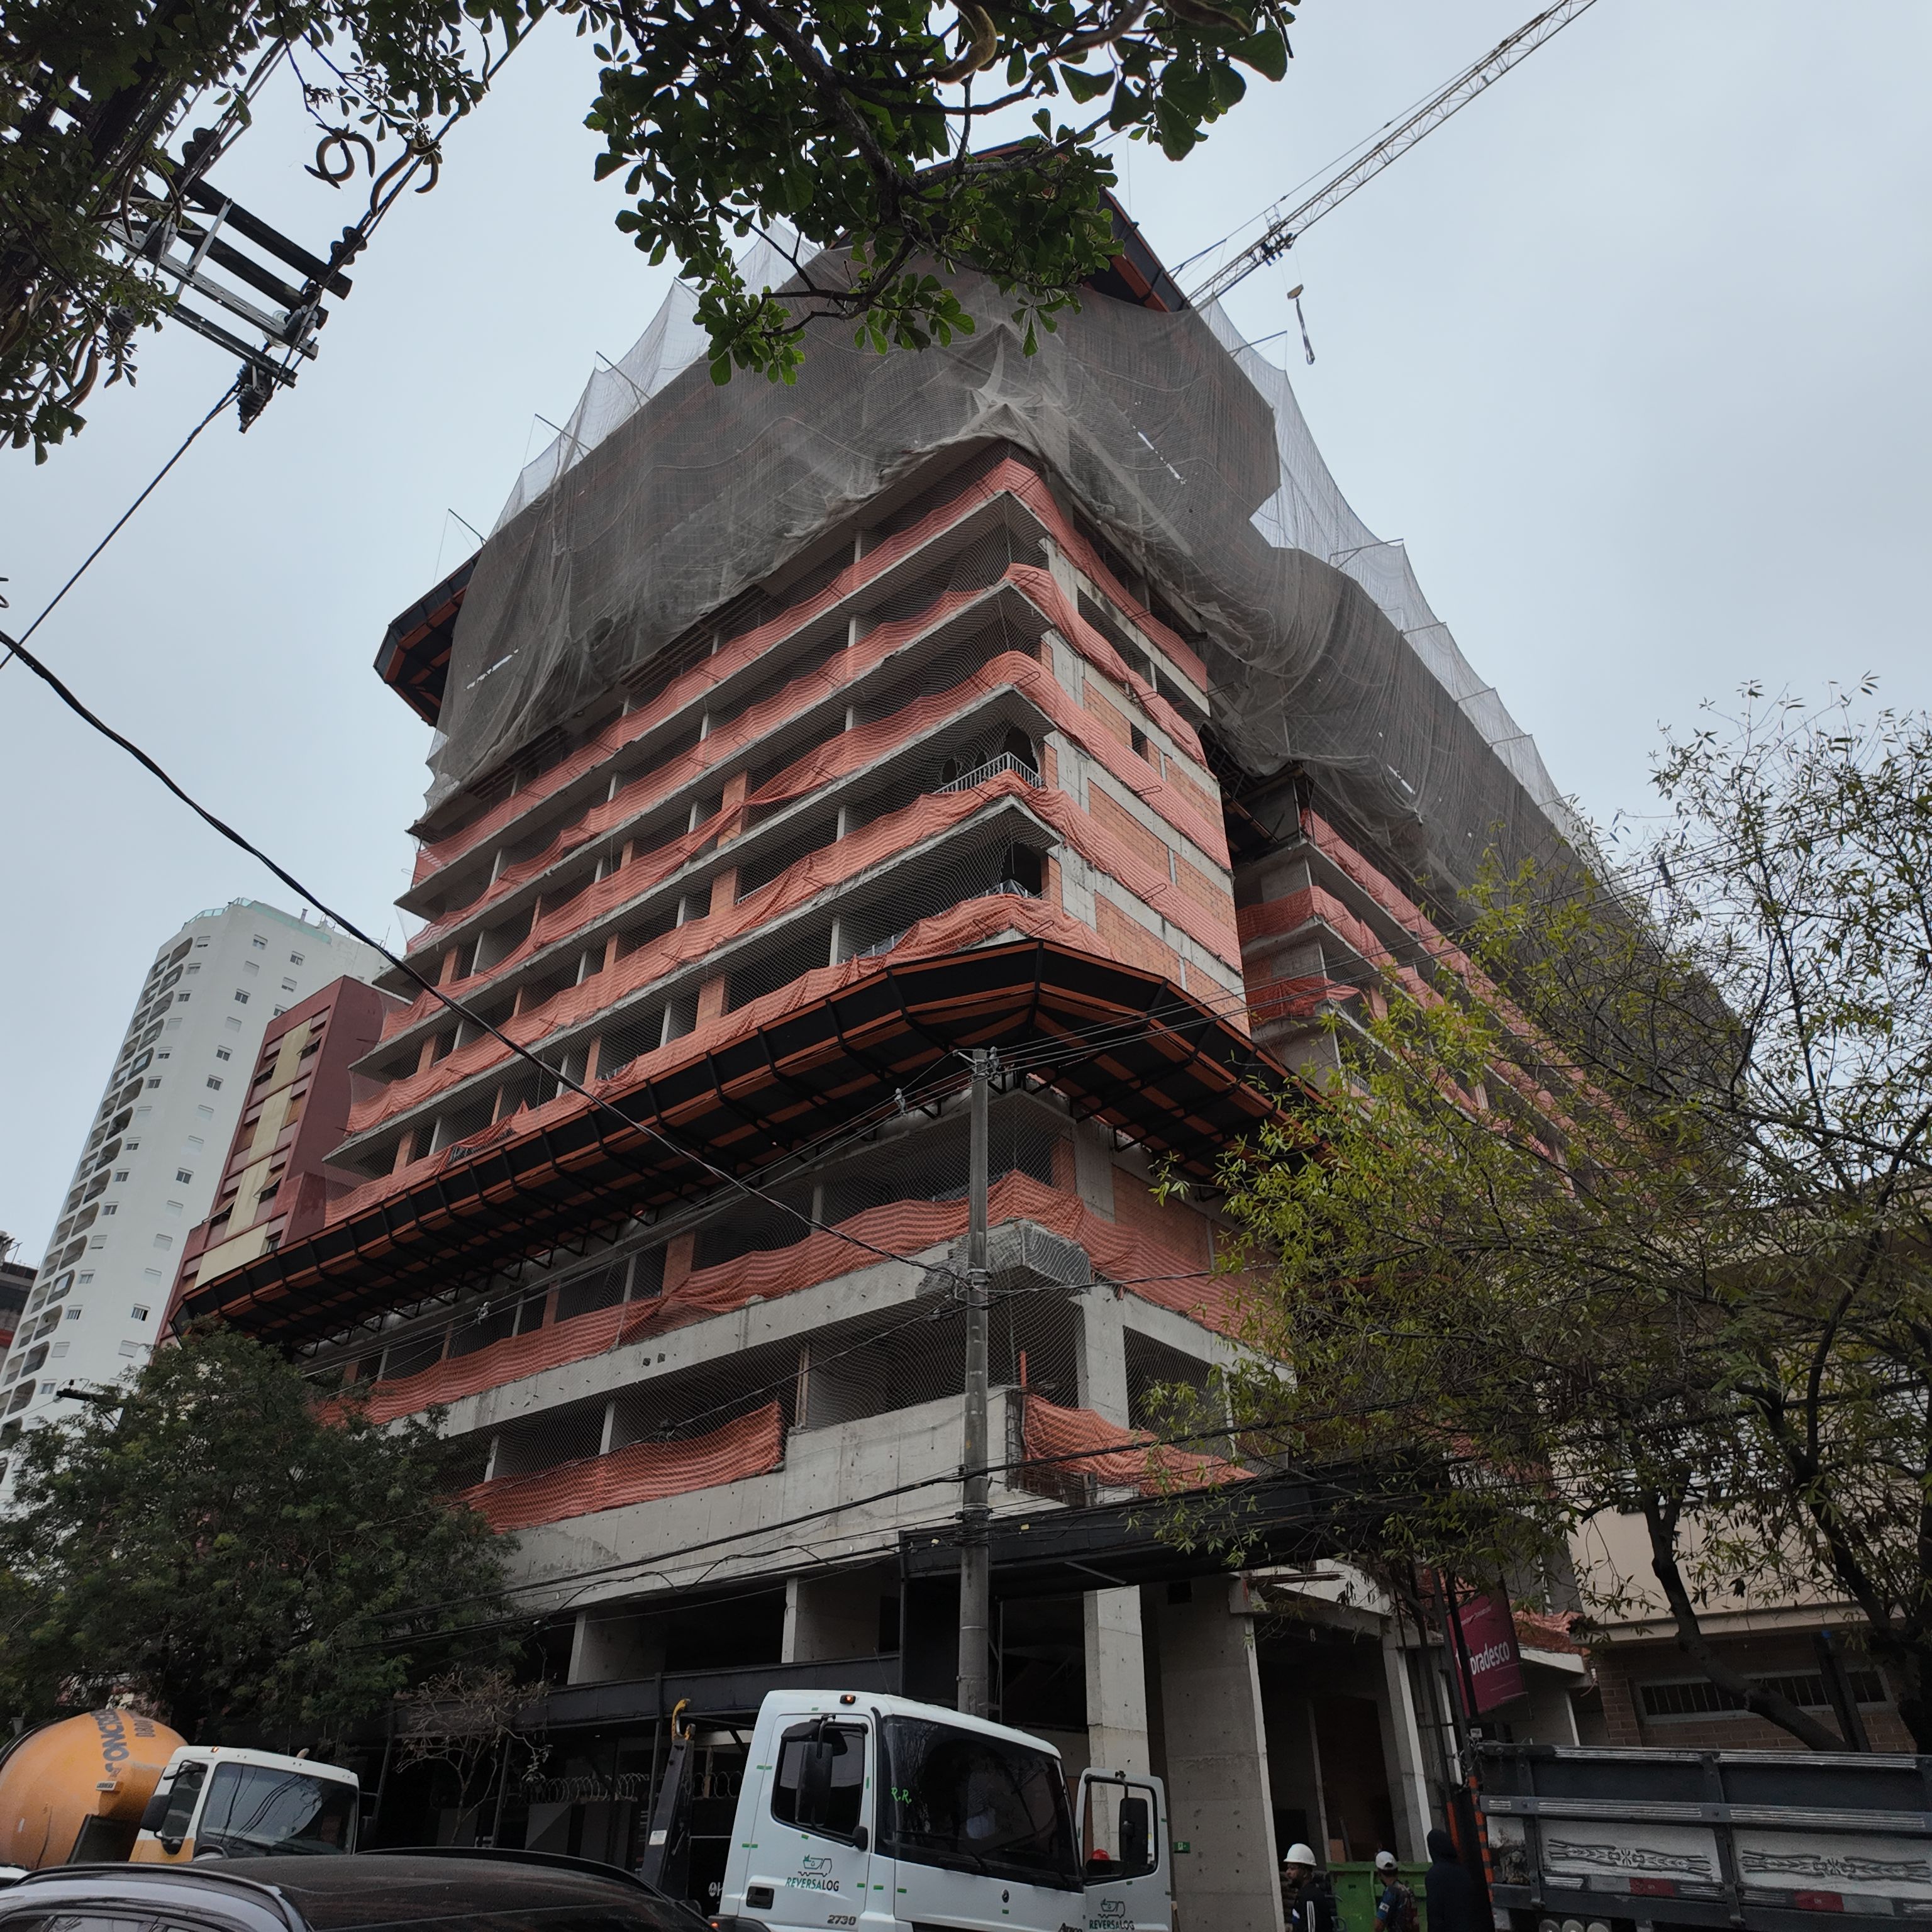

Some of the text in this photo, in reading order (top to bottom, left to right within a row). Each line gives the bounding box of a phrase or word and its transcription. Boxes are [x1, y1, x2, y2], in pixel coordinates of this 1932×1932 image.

[785, 1877, 840, 1892] REVERSALOG
[827, 1914, 856, 1925] 2730
[1089, 1919, 1135, 1930] REVERSALOG
